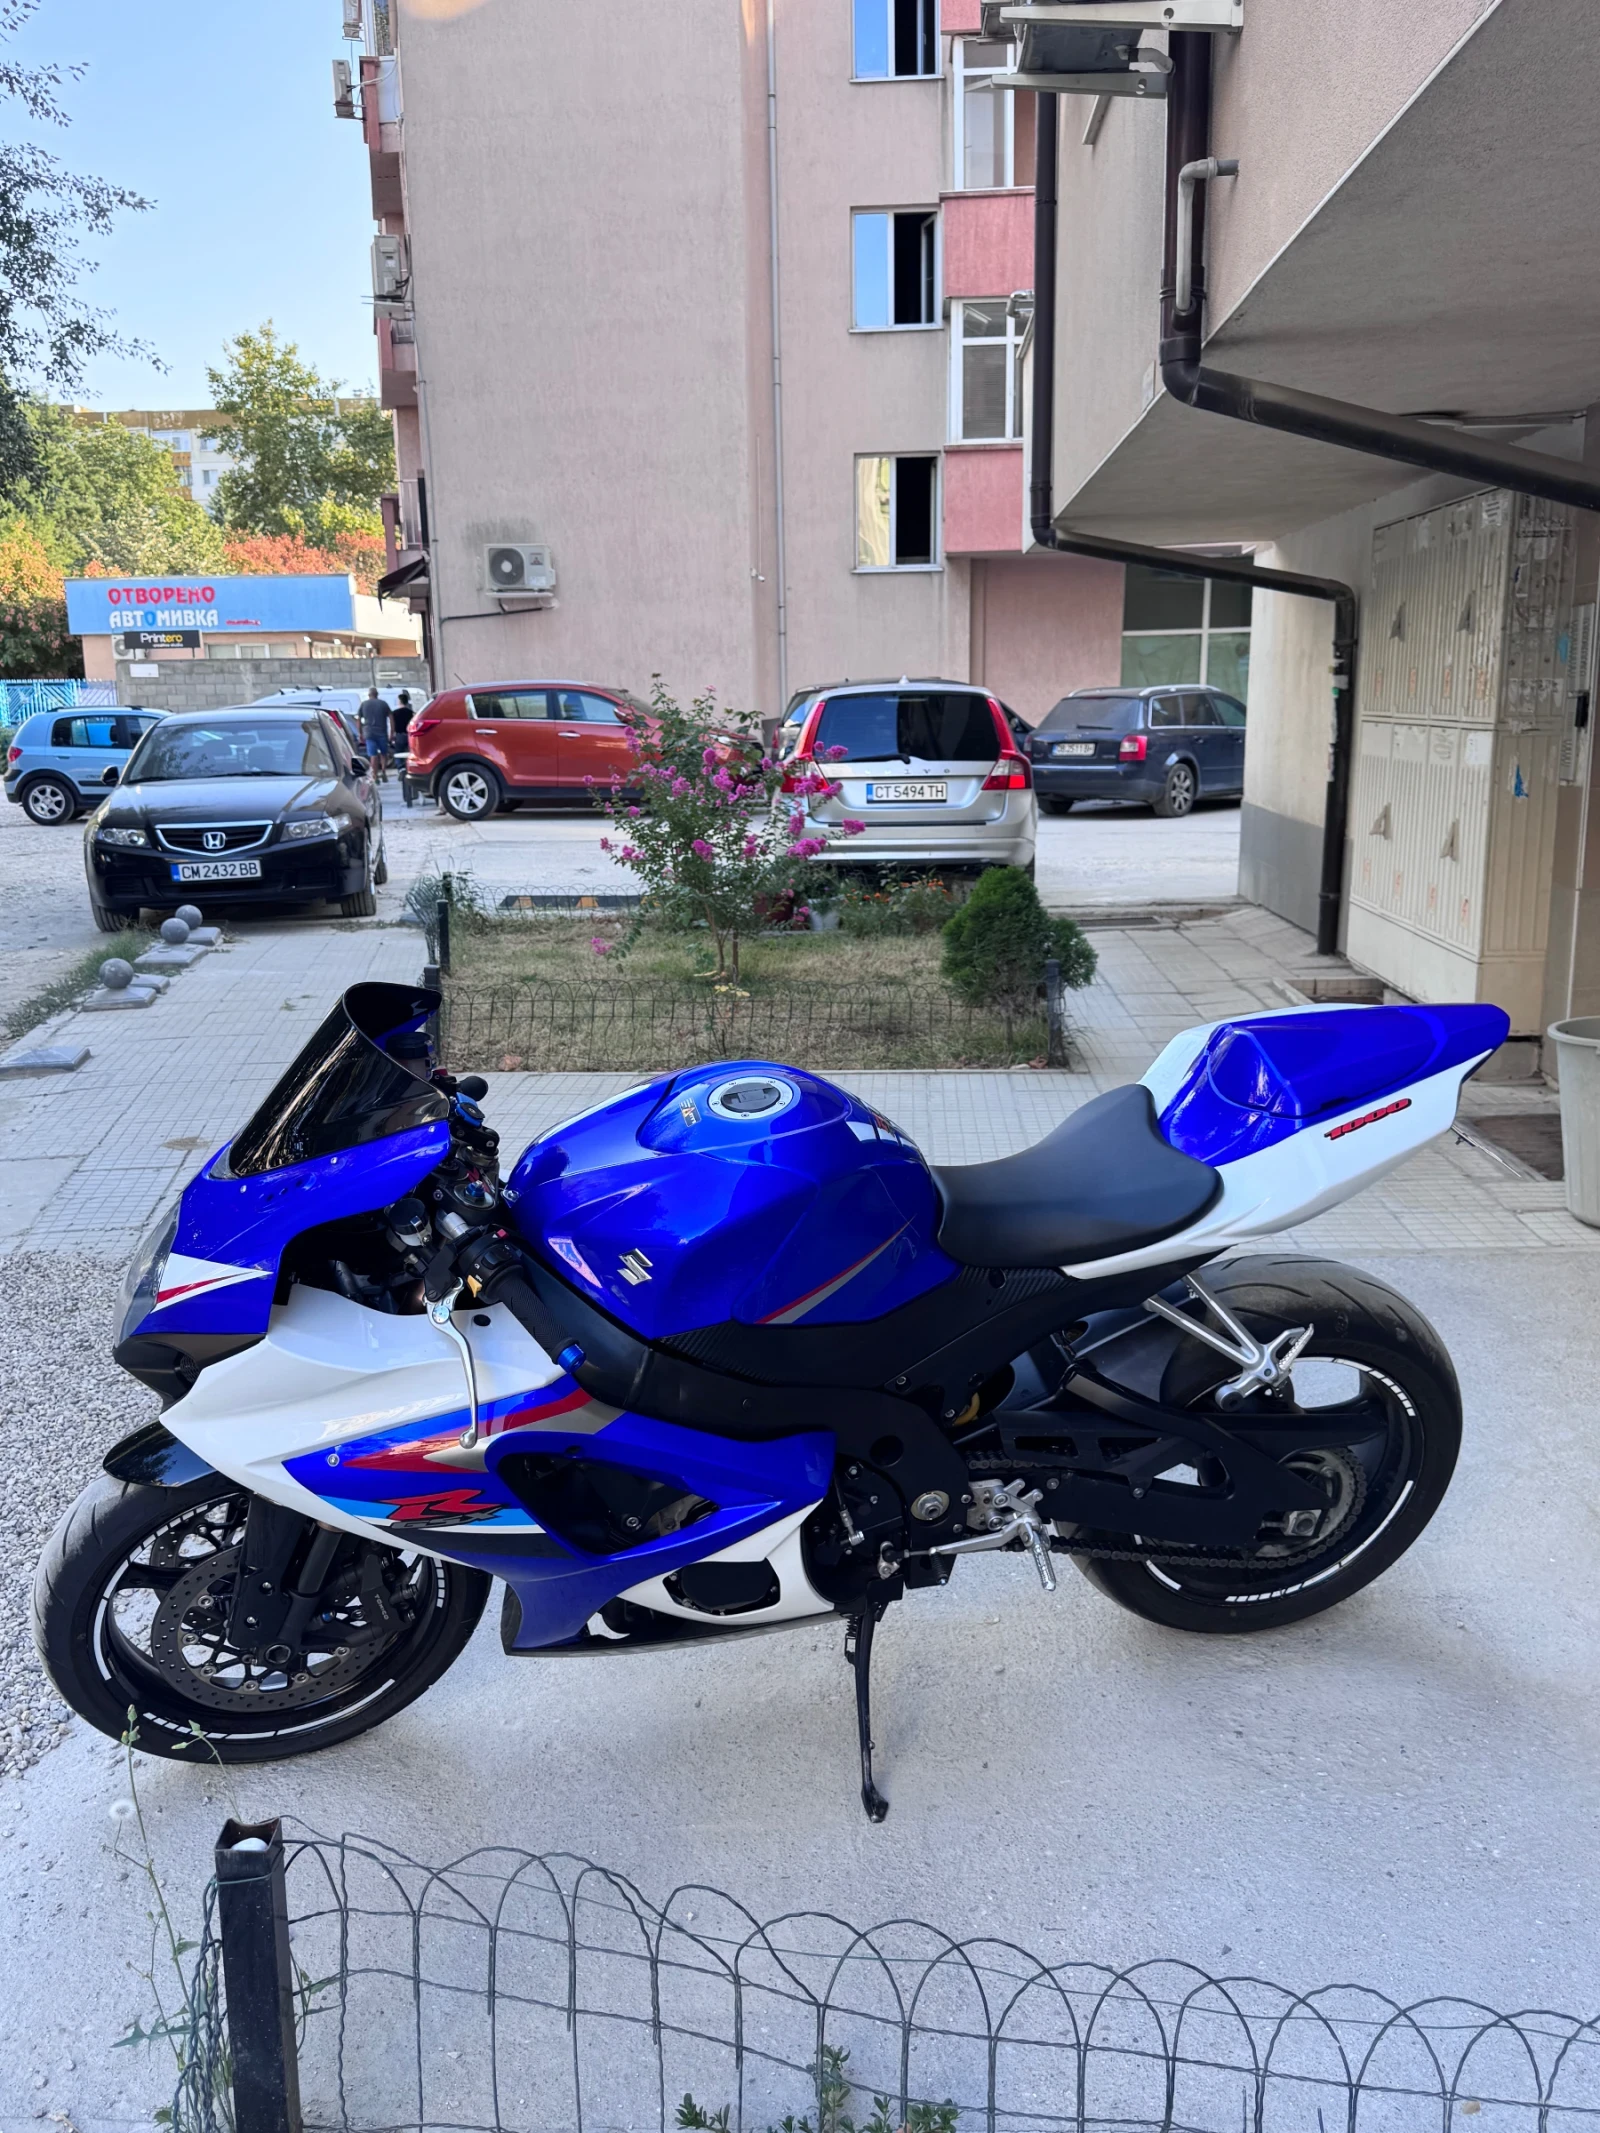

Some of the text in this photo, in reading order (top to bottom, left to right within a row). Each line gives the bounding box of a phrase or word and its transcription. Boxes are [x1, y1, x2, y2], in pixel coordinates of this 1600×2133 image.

[107, 586, 216, 605] ОТВОРЕНО
[109, 609, 219, 629] АВТОМИВКА
[140, 632, 184, 644] Printero
[875, 784, 945, 799] CT 5494 TH
[181, 865, 201, 879] CM
[202, 863, 238, 878] 2432
[239, 862, 258, 876] BB
[1324, 1098, 1412, 1140] 1000
